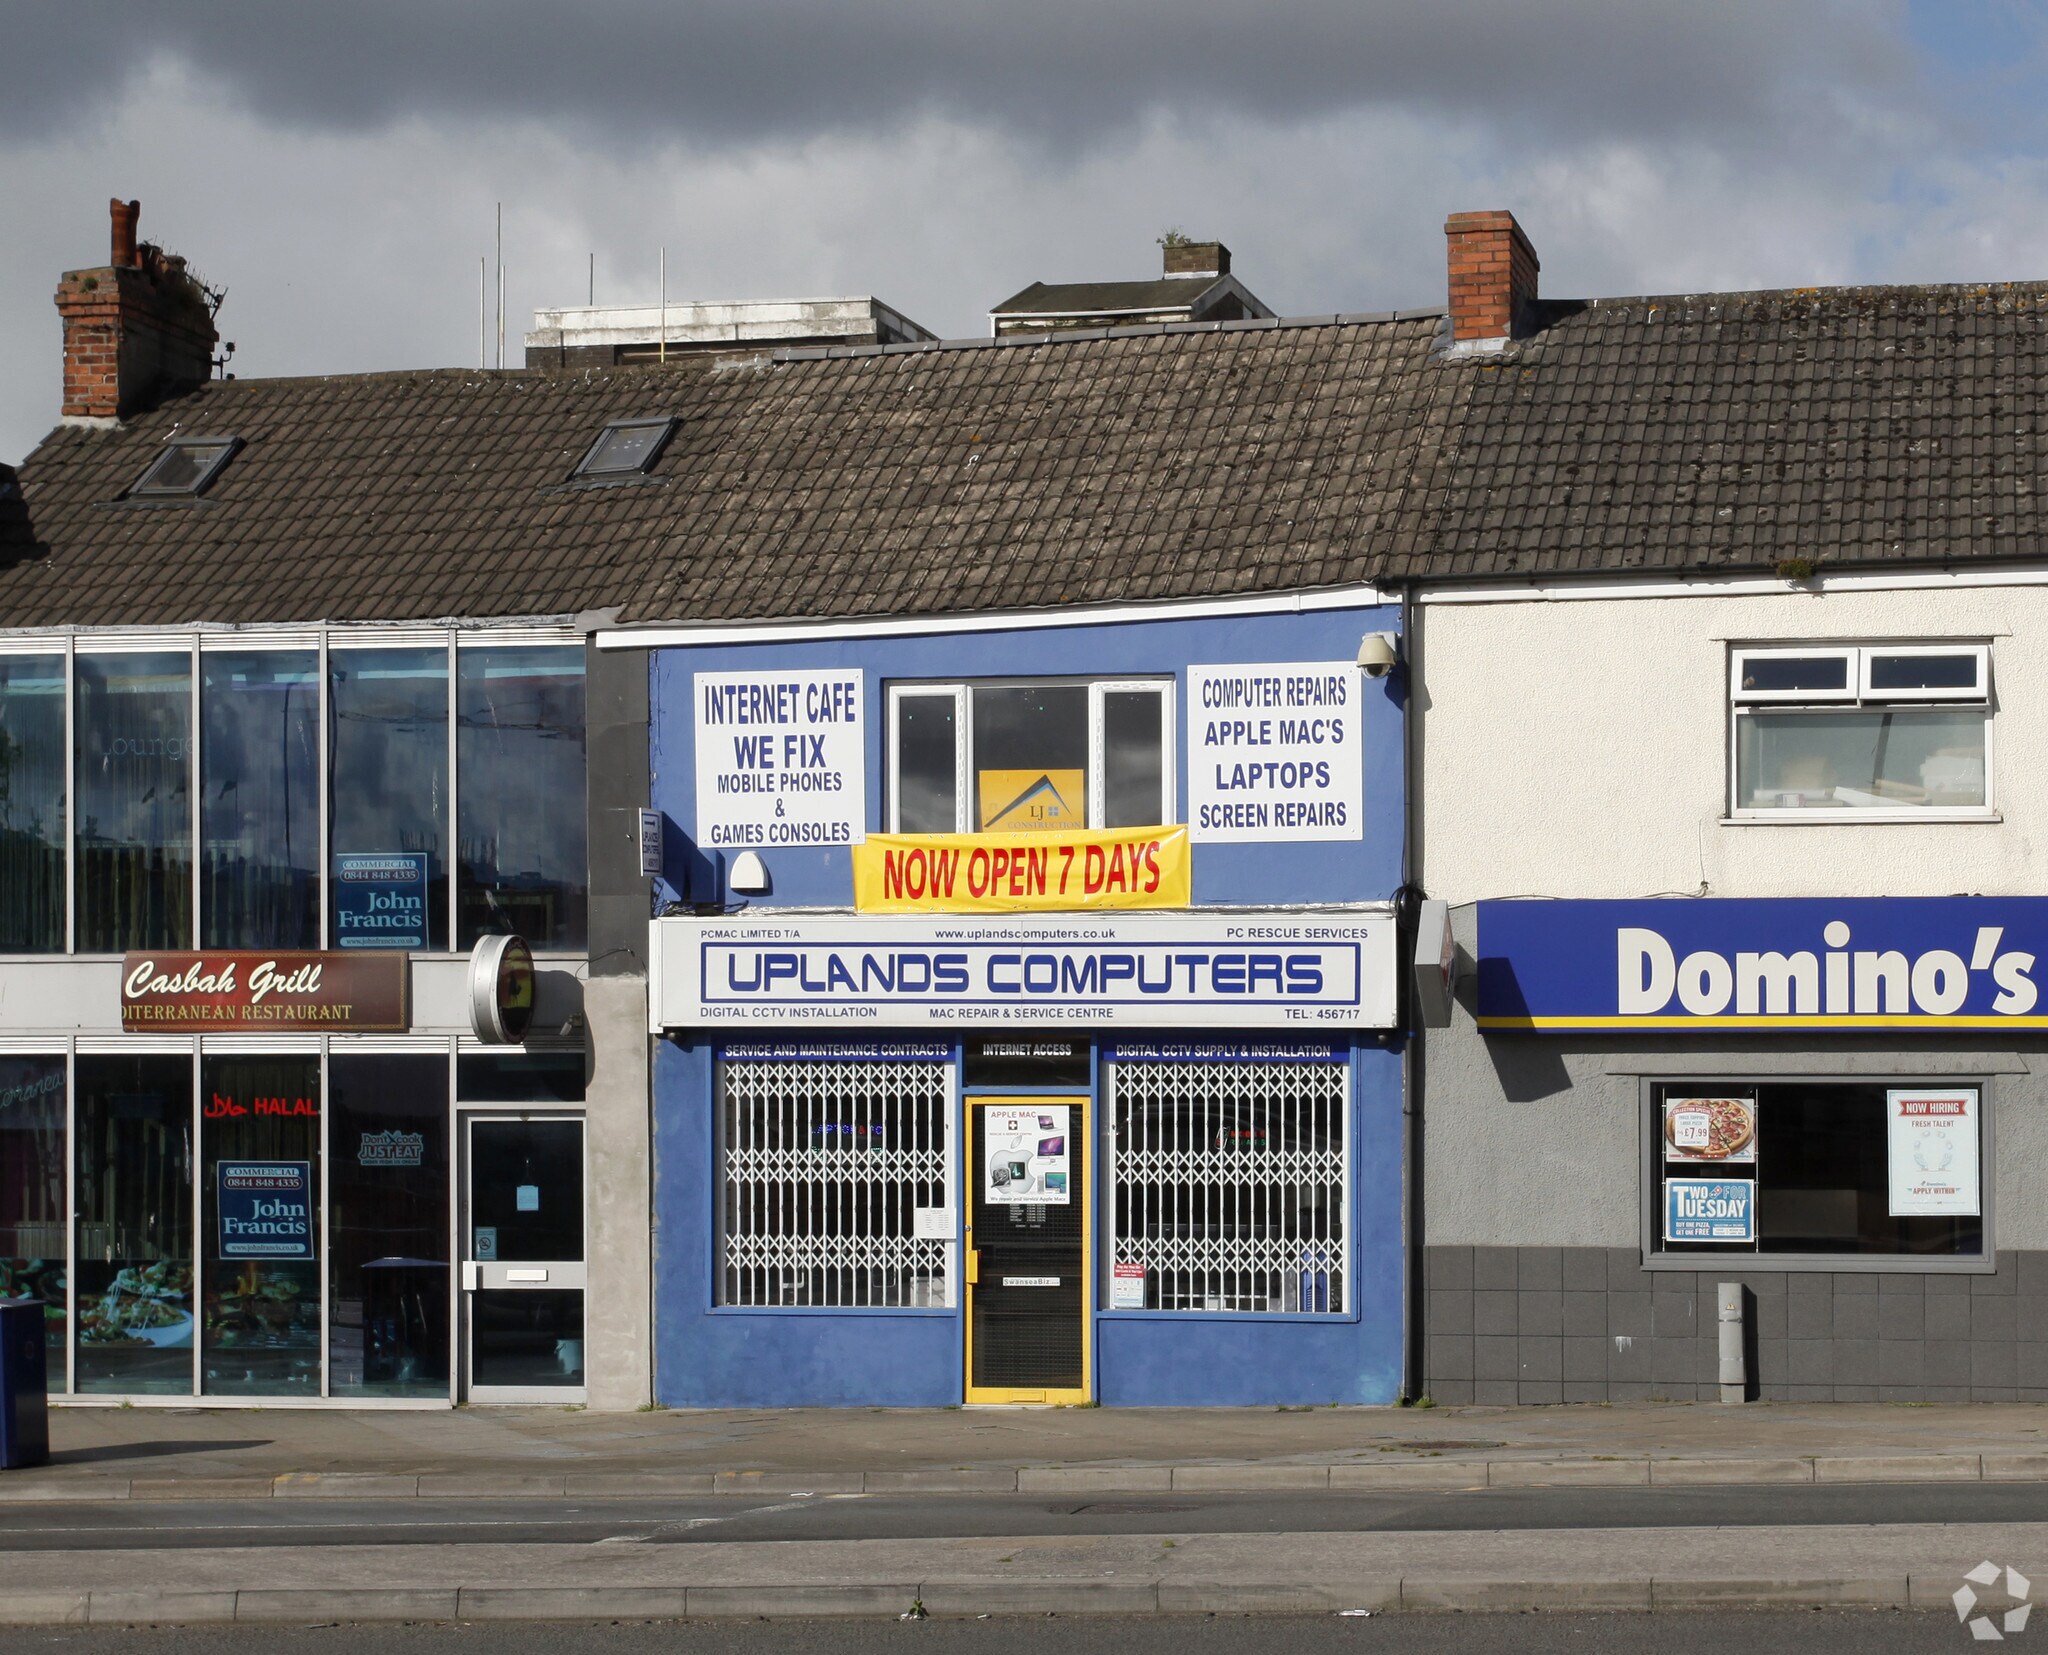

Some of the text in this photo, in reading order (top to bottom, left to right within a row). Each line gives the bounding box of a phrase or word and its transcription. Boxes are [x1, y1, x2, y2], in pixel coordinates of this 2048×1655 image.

[1202, 676, 1346, 708] COMPUTER REPAIRS
[705, 683, 856, 725] INTERNET CAFE
[1204, 719, 1344, 746] APPLE MAC'S
[104, 738, 193, 760] ounge
[733, 734, 827, 769] WE FIX
[717, 772, 842, 793] MOBILE PHONES
[1216, 761, 1331, 790] LAPTOPS
[774, 798, 785, 817] &
[1030, 805, 1044, 820] LJ
[1200, 802, 1347, 829] SCREEN REPAIRS
[711, 822, 850, 843] GAMES CONSOLES
[1008, 821, 1081, 829] CONSTRUCTION
[344, 870, 416, 880] 0844 848 4335
[884, 840, 1161, 899] NOW OPEN 7 DAYS
[368, 891, 422, 913] John
[338, 909, 423, 928] Francis
[701, 930, 800, 939] PCMAC LIMITED T/A
[935, 929, 1116, 941] www.uplandscomputers.co.uk
[1226, 928, 1368, 939] PC RESCUE SERVICES
[728, 953, 1323, 994] UPLANDS COMPUTERS
[1617, 920, 2038, 1015] Domino's
[125, 960, 323, 1004] Casbah Grill
[242, 1005, 352, 1020] RESTAURANT
[700, 1007, 877, 1018] DIGITAL CCTV INSTALLATION
[929, 1008, 1114, 1018] MAC REPAIR & SERVICE CENTRE
[1285, 1009, 1360, 1019] TEL: 456717
[725, 1044, 949, 1056] SERVICE AND MAINTENANCE CONTRACTS
[982, 1044, 1072, 1056] INTERNET ACCESS
[1116, 1044, 1331, 1057] DIGITAL CCTV SUPPLY & INSTALLATION
[203, 1092, 248, 1118] حلال
[254, 1098, 318, 1115] HALAL
[1906, 1103, 1960, 1113] NOW HIRING
[396, 1134, 421, 1144] cook
[1684, 1127, 1707, 1139] £7.99
[360, 1145, 421, 1158] JUST EAT
[227, 1168, 297, 1176] COMMERCIAL
[228, 1178, 300, 1187] 0844 848 4335
[1722, 1185, 1746, 1200] FOR
[252, 1199, 306, 1219] John
[1673, 1186, 1746, 1218] TUESDAY
[223, 1217, 307, 1235] Francis
[1695, 1228, 1709, 1236] FREE
